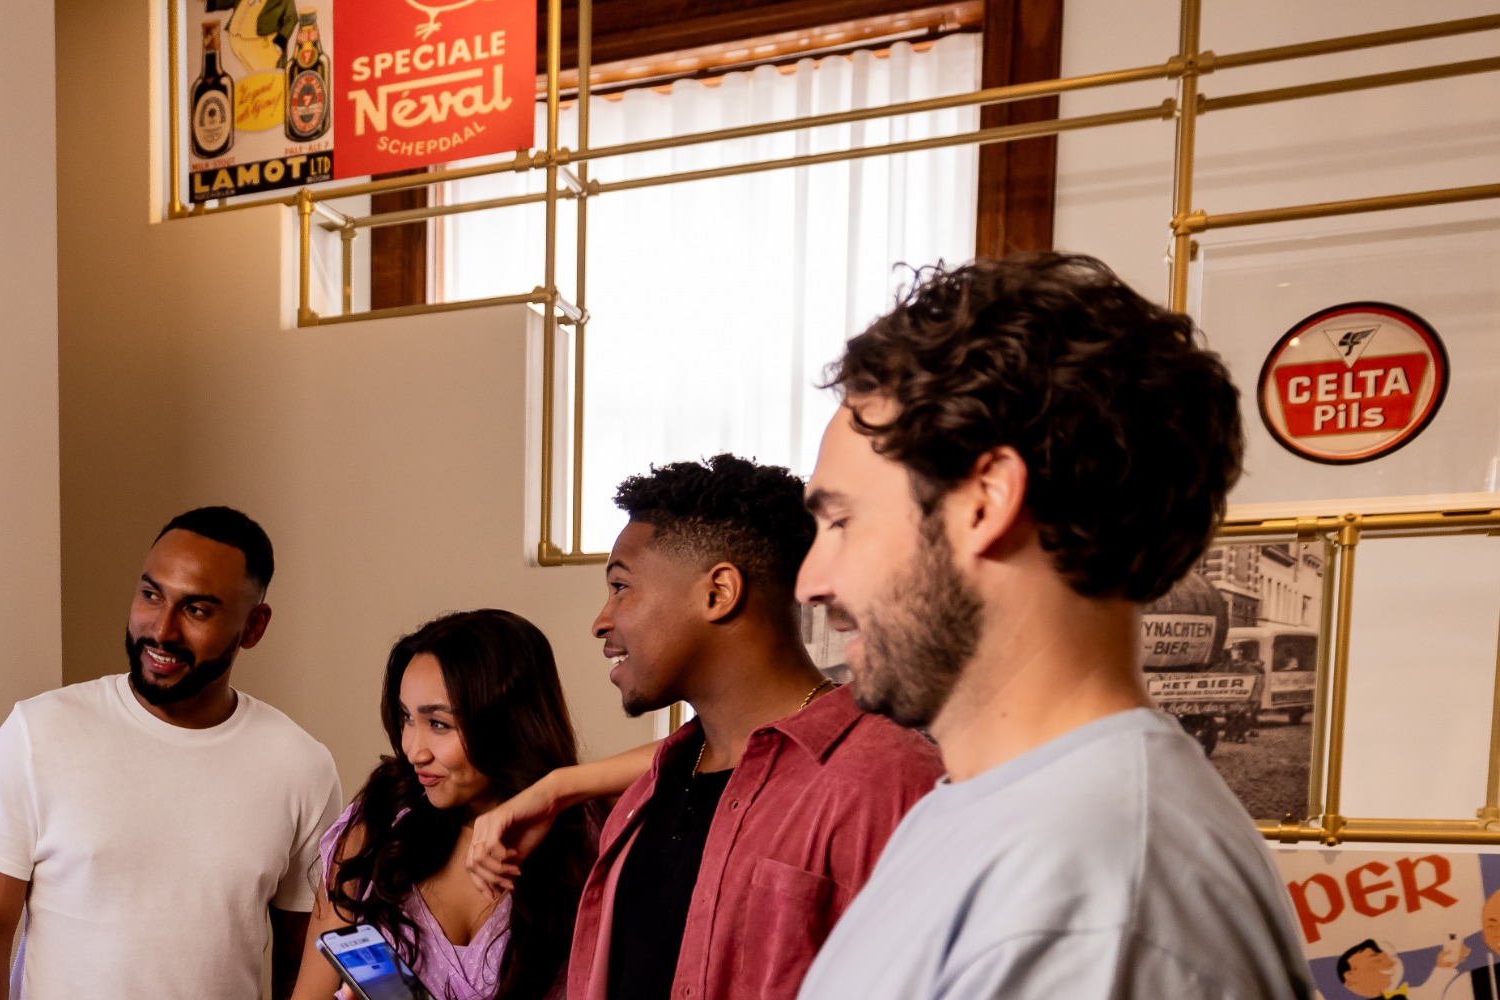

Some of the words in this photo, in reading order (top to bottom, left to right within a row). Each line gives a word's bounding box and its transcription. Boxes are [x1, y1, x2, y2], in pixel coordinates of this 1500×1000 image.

[351, 30, 506, 82] SPECIALE
[347, 63, 513, 136] Néval
[376, 121, 486, 156] SCHEPDAAL
[193, 155, 308, 194] LAMOT
[310, 156, 331, 176] LTD
[1287, 366, 1411, 404] CELTA
[1313, 402, 1385, 432] Pils
[1162, 681, 1191, 690] HET
[1196, 678, 1244, 690] BIER
